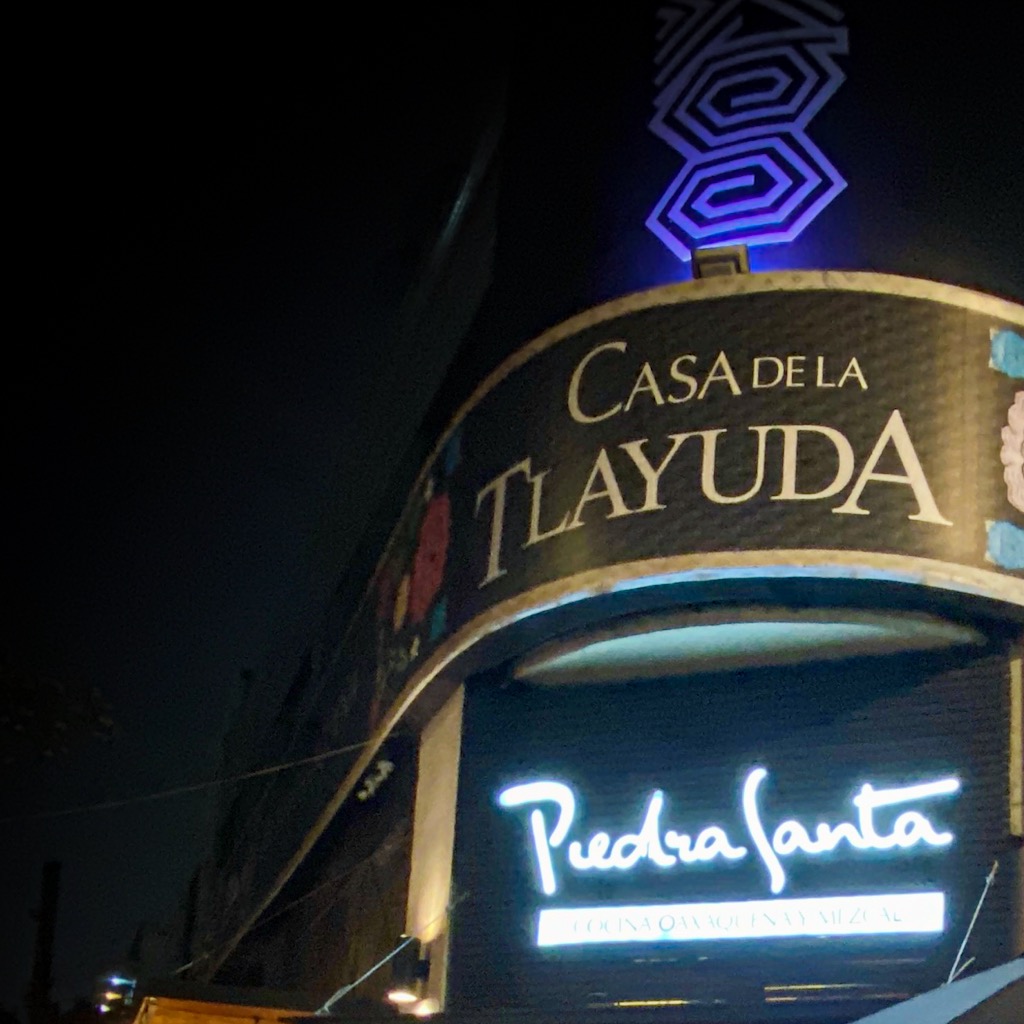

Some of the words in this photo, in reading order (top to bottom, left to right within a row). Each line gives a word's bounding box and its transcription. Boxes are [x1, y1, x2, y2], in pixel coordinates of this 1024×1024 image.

[568, 341, 741, 426] CASA
[752, 355, 807, 388] DE
[816, 355, 868, 390] LA
[475, 409, 953, 590] TLAYUDA
[499, 780, 747, 896] Piedra
[742, 766, 961, 895] Santa
[574, 915, 651, 934] COCINA
[818, 904, 903, 925] MEZCAL
